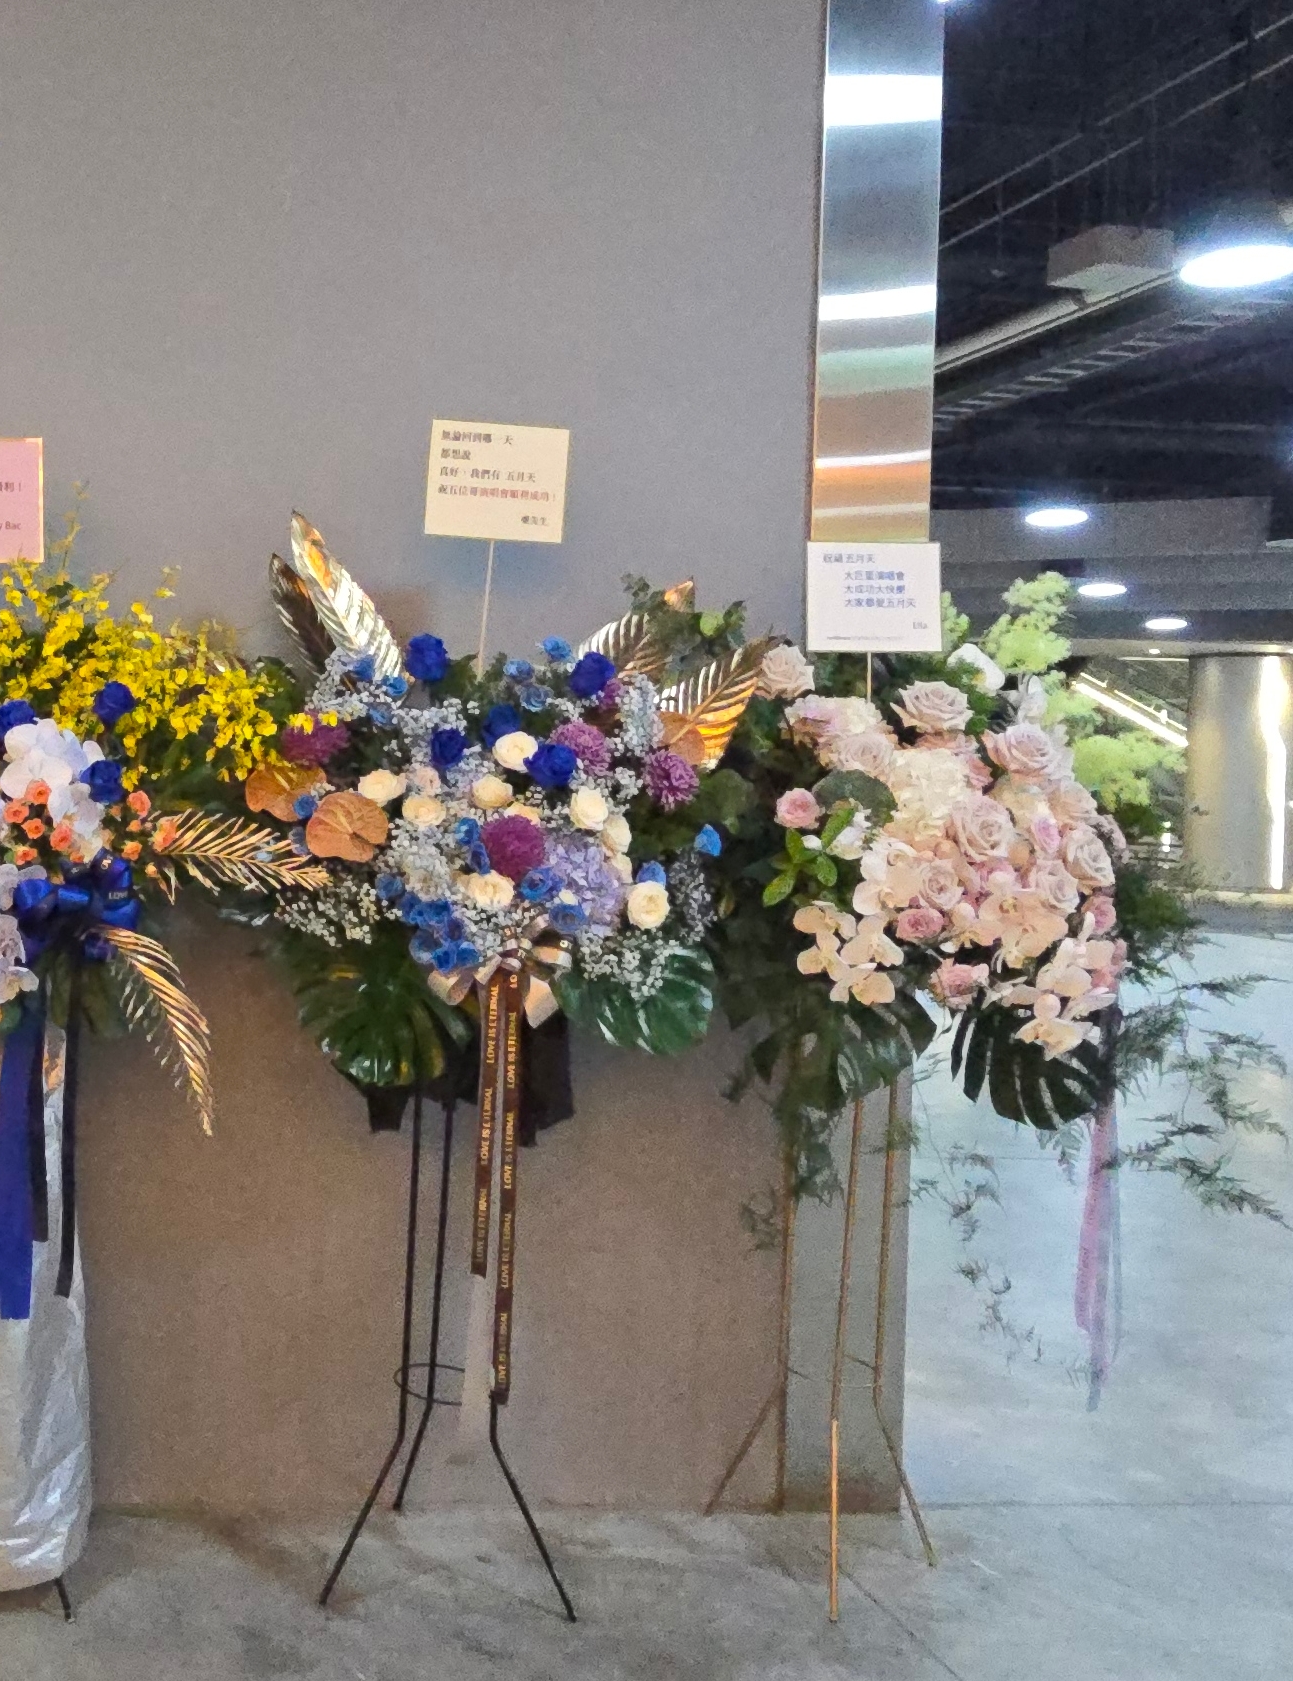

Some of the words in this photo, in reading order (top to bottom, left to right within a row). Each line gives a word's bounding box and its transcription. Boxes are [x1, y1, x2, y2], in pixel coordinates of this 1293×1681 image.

[505, 470, 537, 483] 五月天
[844, 570, 905, 581] 大巨蛋演唱會
[489, 984, 499, 1027] ETERNAL
[486, 1040, 496, 1064] LOVE
[480, 1141, 490, 1165] LOVE
[504, 1165, 513, 1189] LOVE
